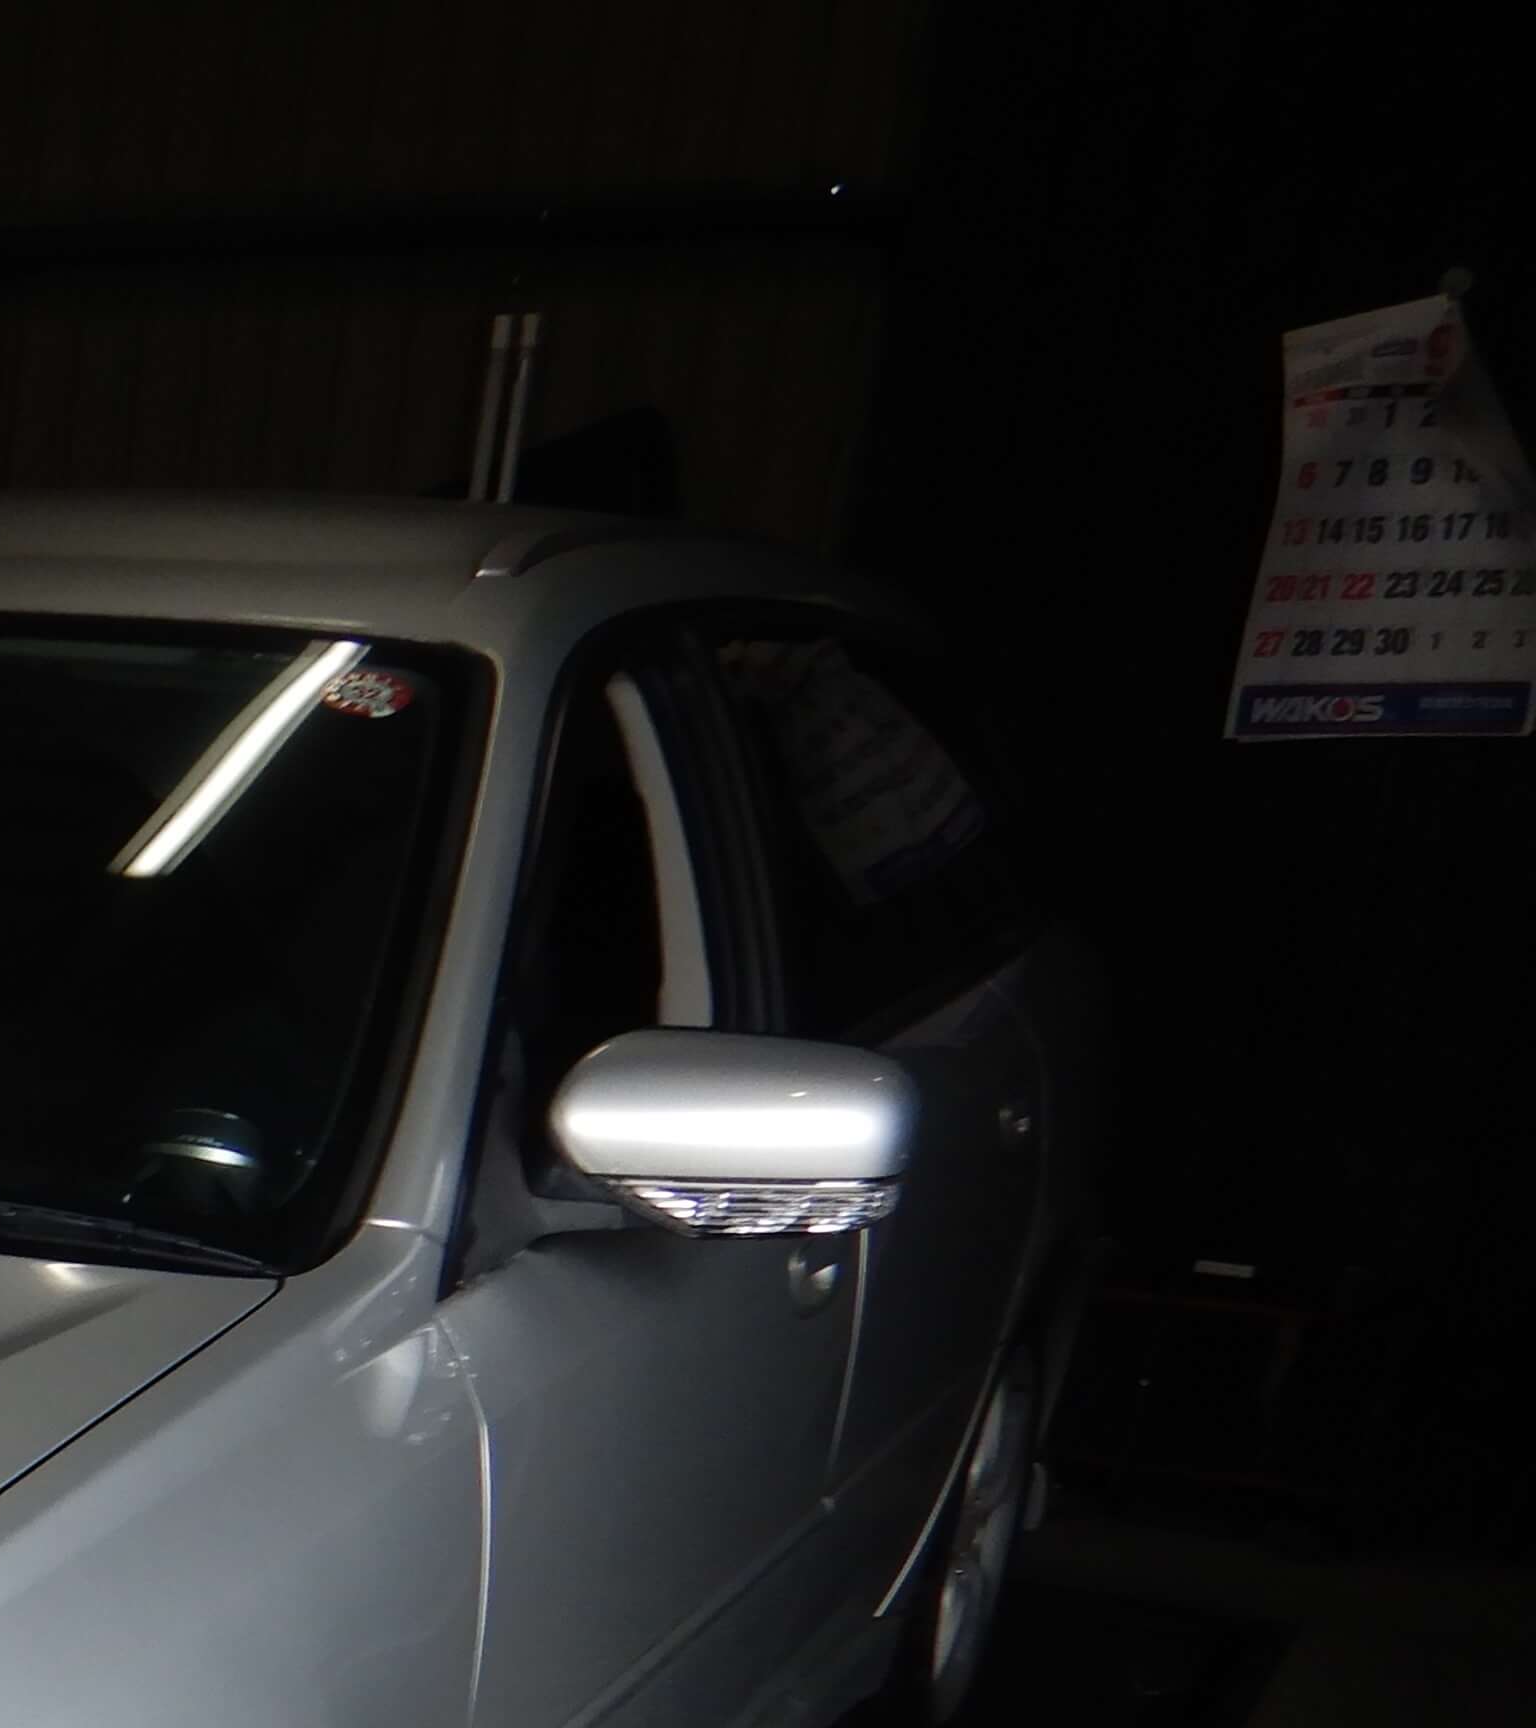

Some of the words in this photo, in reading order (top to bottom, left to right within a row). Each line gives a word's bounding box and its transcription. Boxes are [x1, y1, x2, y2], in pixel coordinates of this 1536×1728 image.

[1298, 462, 1318, 489] 6
[1335, 460, 1353, 488] 7
[1369, 458, 1388, 486] 8
[1410, 457, 1433, 485] 9
[1317, 517, 1345, 545] 14
[1355, 515, 1385, 543] 15
[1398, 514, 1429, 542] 16
[1443, 513, 1475, 541] 17
[1266, 576, 1298, 602] 20
[1302, 576, 1332, 600] 21
[1340, 573, 1377, 600] 22
[1384, 572, 1419, 599] 23
[1428, 571, 1465, 597] 24
[1472, 569, 1506, 597] 25
[1254, 630, 1284, 657] 27
[1291, 629, 1324, 657] 28
[1330, 628, 1364, 656] 29
[1373, 627, 1410, 655] 30
